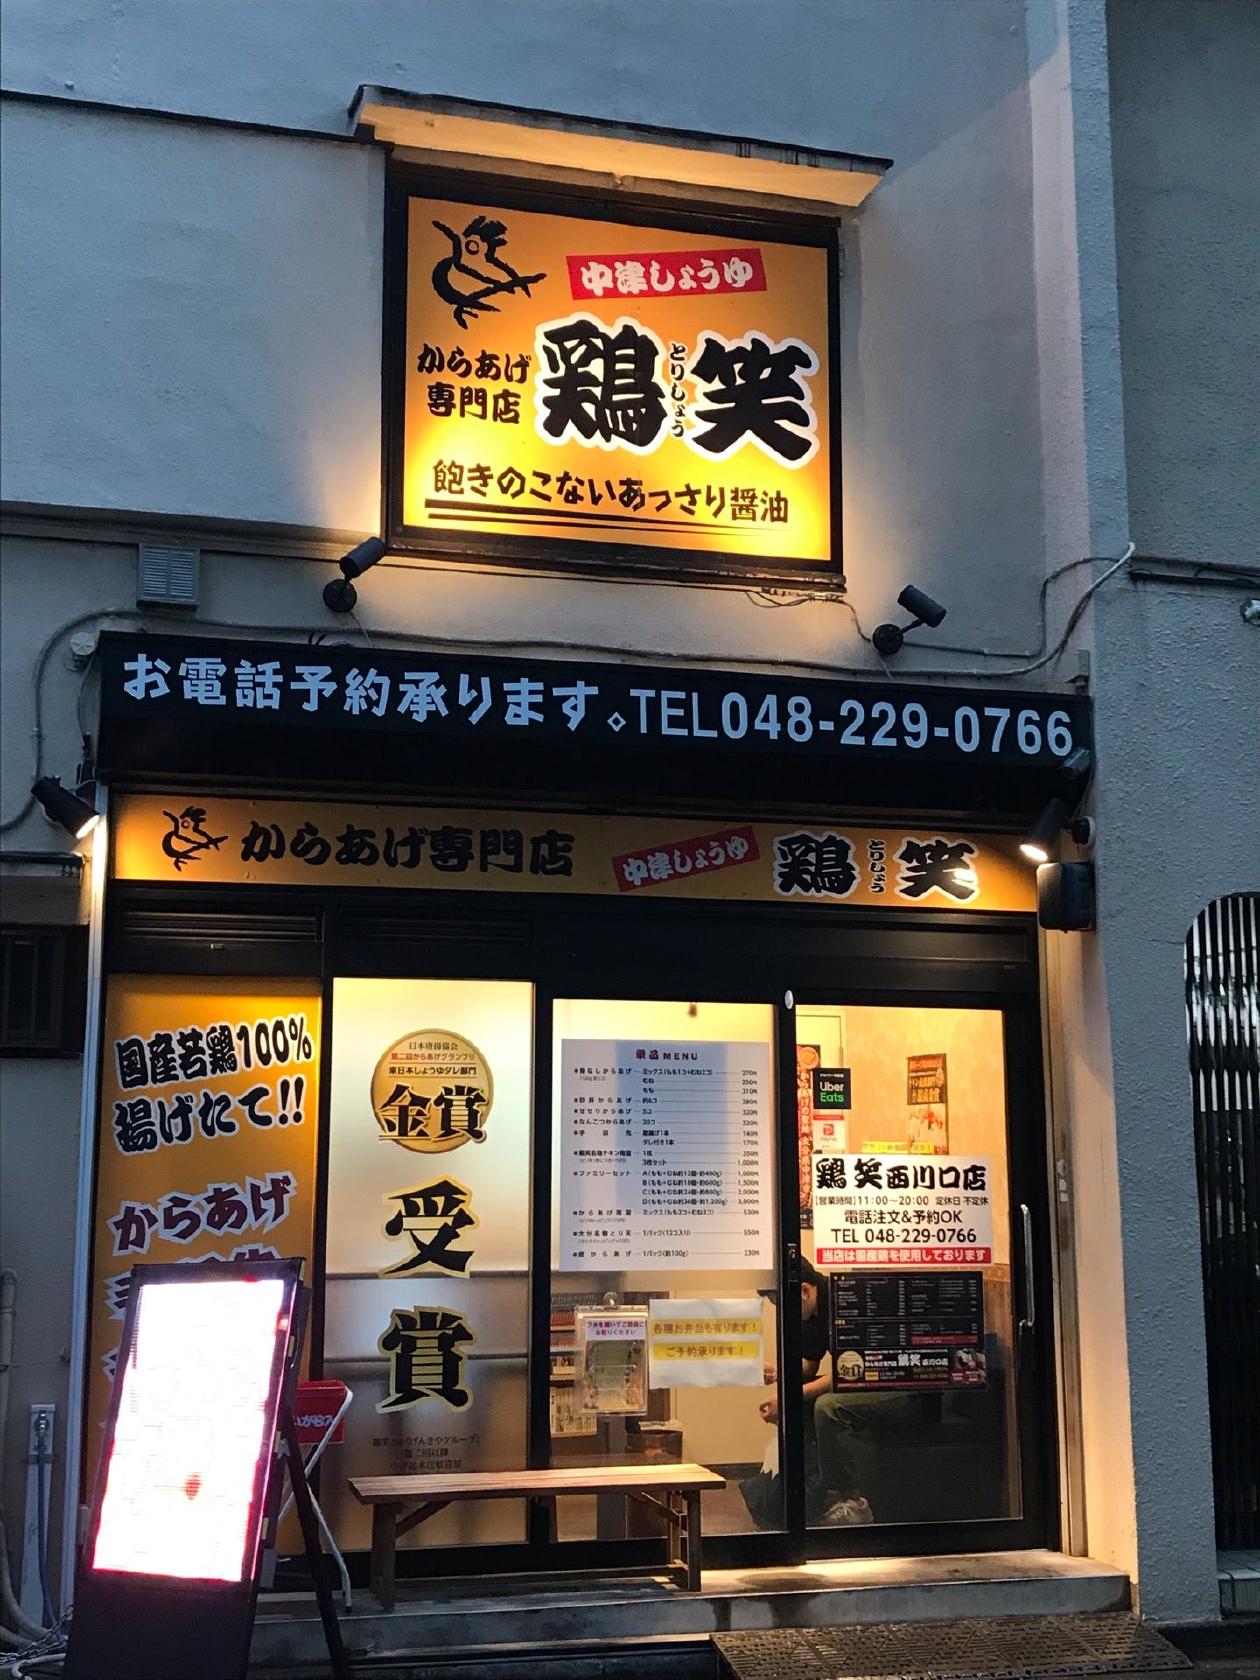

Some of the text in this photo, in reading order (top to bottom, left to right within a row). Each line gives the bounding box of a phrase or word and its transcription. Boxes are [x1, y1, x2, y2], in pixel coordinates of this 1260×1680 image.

[582, 259, 754, 295] 中津しょうゆ
[416, 343, 531, 384] からあげ
[427, 382, 521, 424] 専門店
[669, 342, 687, 438] とりしょう
[434, 459, 789, 523] 飽きのこないあっさり醤油
[240, 821, 575, 876] からあげ専門店
[621, 834, 750, 886] 中津しょうゆ
[409, 1042, 458, 1051] 日本唐揚協会
[663, 1052, 698, 1060] MENU
[389, 1066, 476, 1075] 東日本しょうゆダレ部門
[820, 1082, 844, 1092] Uber
[379, 1084, 487, 1140] 金賞
[820, 1093, 844, 1103] Eats
[113, 1175, 292, 1251] からあげ
[936, 1197, 960, 1205] 定休日
[963, 1197, 988, 1205] 不定休
[831, 1229, 976, 1243] TEL 048-229-0766
